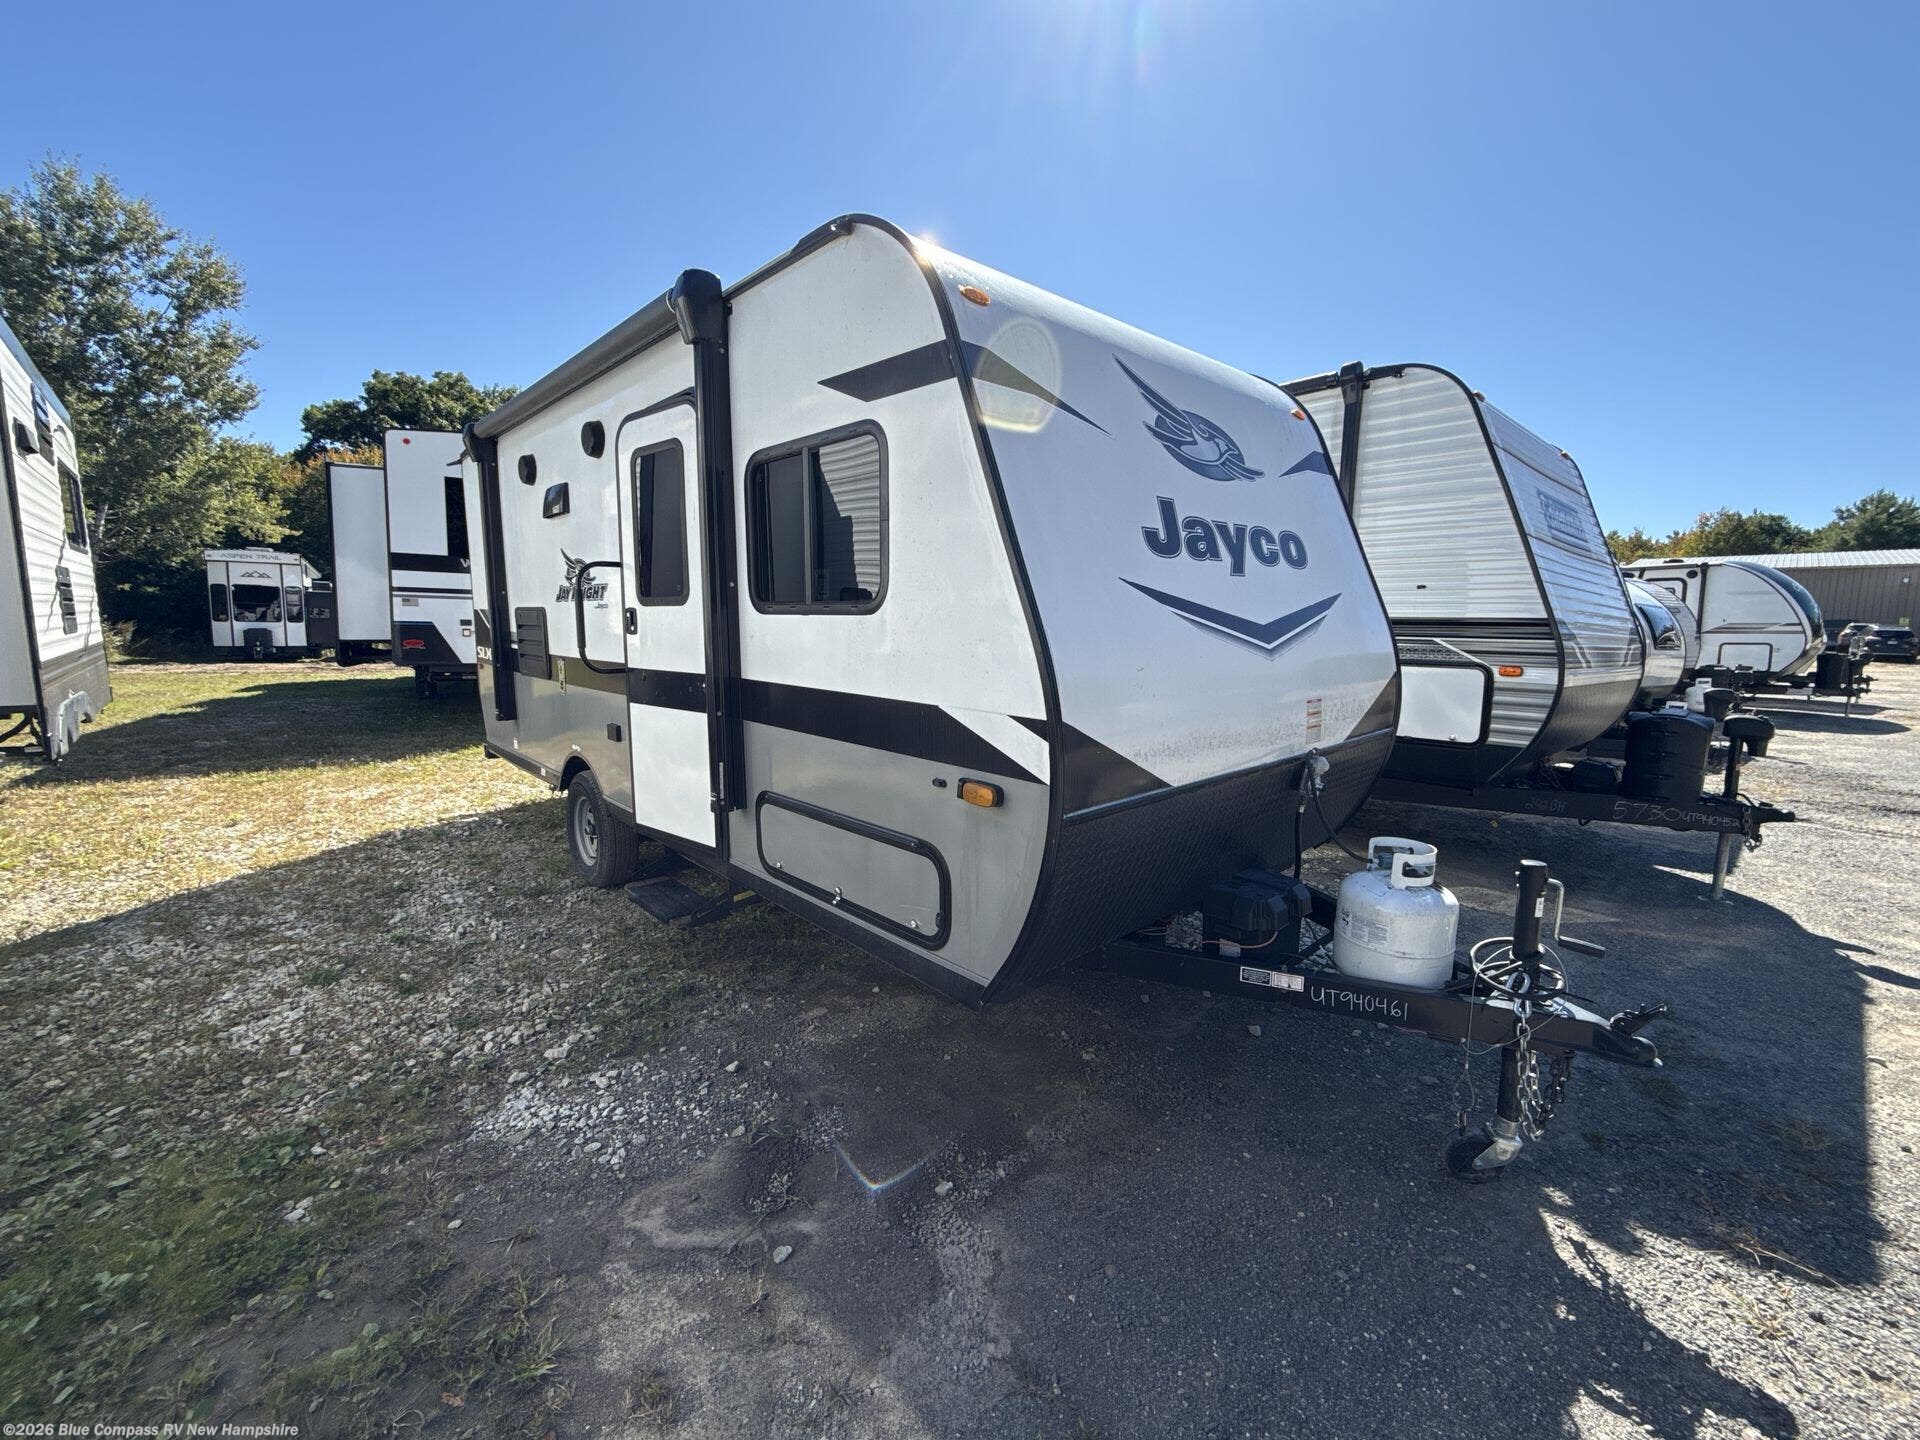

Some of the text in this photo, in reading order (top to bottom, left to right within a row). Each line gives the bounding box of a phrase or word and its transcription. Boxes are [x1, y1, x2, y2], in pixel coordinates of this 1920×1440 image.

[1141, 495, 1308, 577] Jayco
[555, 584, 572, 602] JAY
[476, 645, 493, 660] SLX
[1310, 985, 1409, 1022] UT940461
